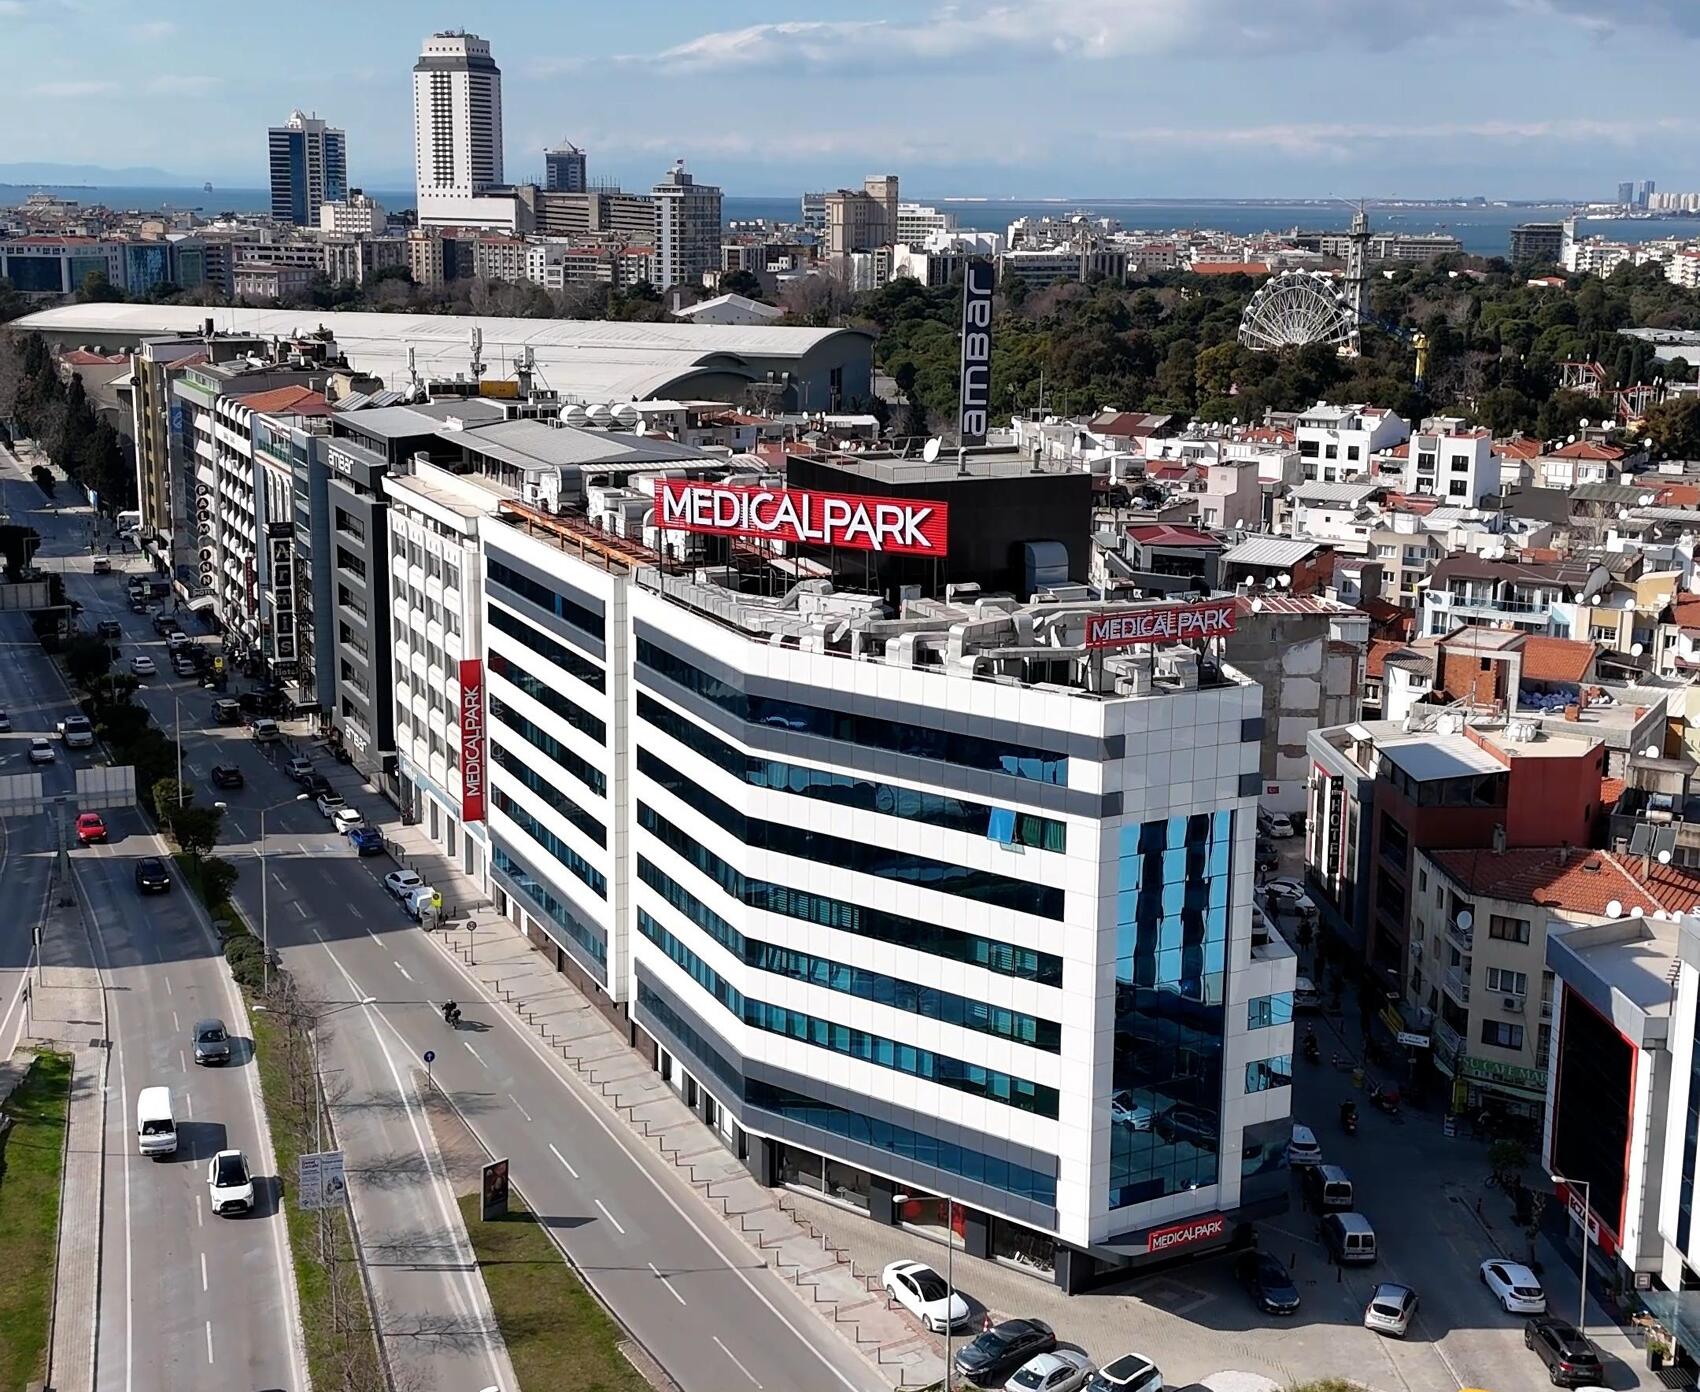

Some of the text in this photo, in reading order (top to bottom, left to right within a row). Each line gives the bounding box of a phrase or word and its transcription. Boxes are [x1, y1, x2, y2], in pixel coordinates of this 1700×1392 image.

[198, 486, 210, 584] PALM INN
[1329, 799, 1340, 870] HOTEL
